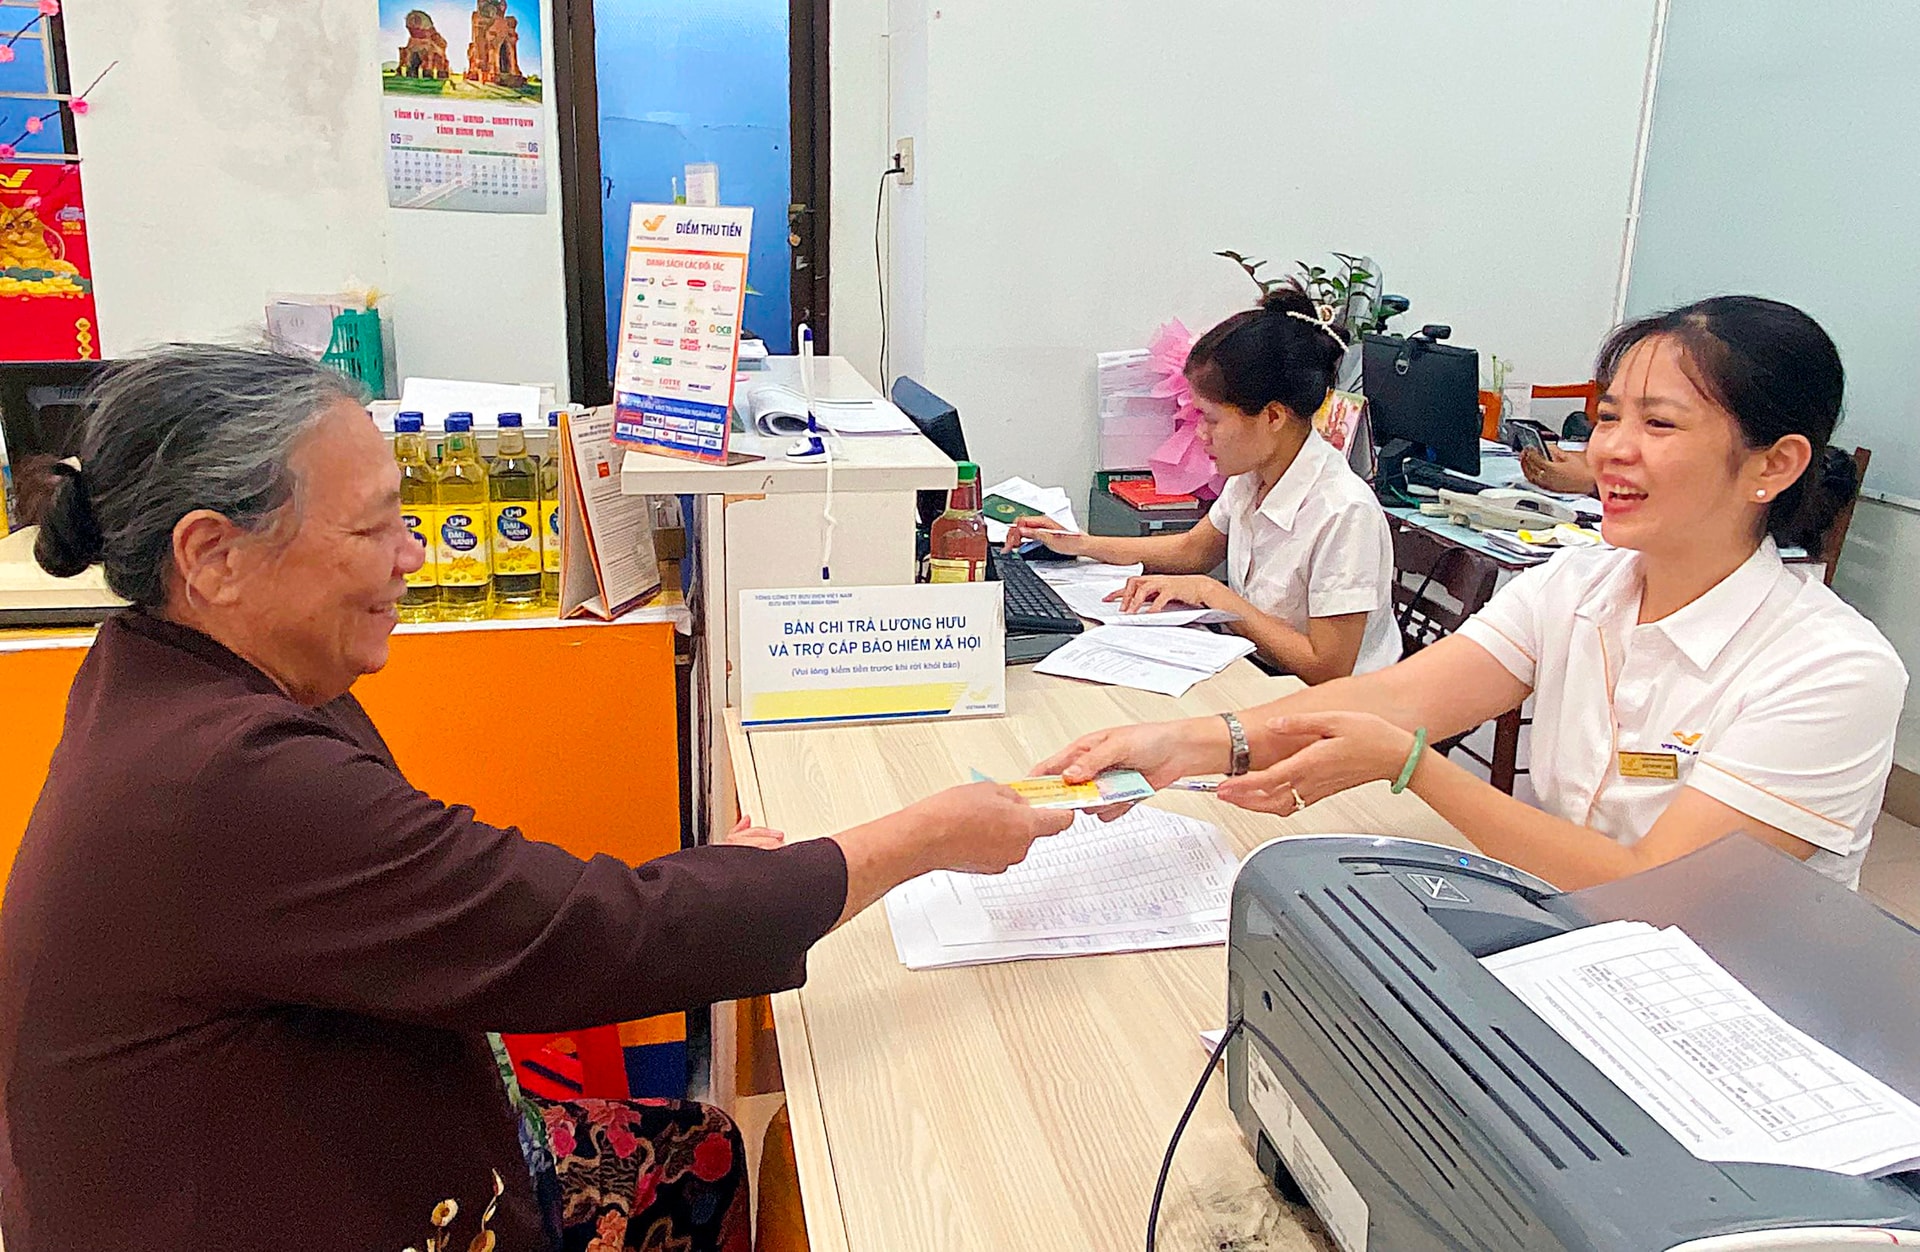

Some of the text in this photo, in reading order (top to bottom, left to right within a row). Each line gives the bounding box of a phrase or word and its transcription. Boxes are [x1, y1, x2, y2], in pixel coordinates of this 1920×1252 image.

[391, 133, 402, 144] 05
[528, 142, 539, 153] 06
[701, 223, 720, 236] THU
[716, 325, 732, 334] OCB
[818, 621, 843, 634] CHI
[847, 617, 876, 633] TRẢ
[880, 617, 932, 632] LƯƠNG
[936, 615, 967, 630] HƯU
[769, 640, 789, 657] VÀ
[793, 641, 825, 658] TRỢ
[862, 637, 893, 653] BẢO
[934, 634, 953, 650] XÃ
[957, 634, 981, 652] HỘI
[895, 662, 908, 672] khi
